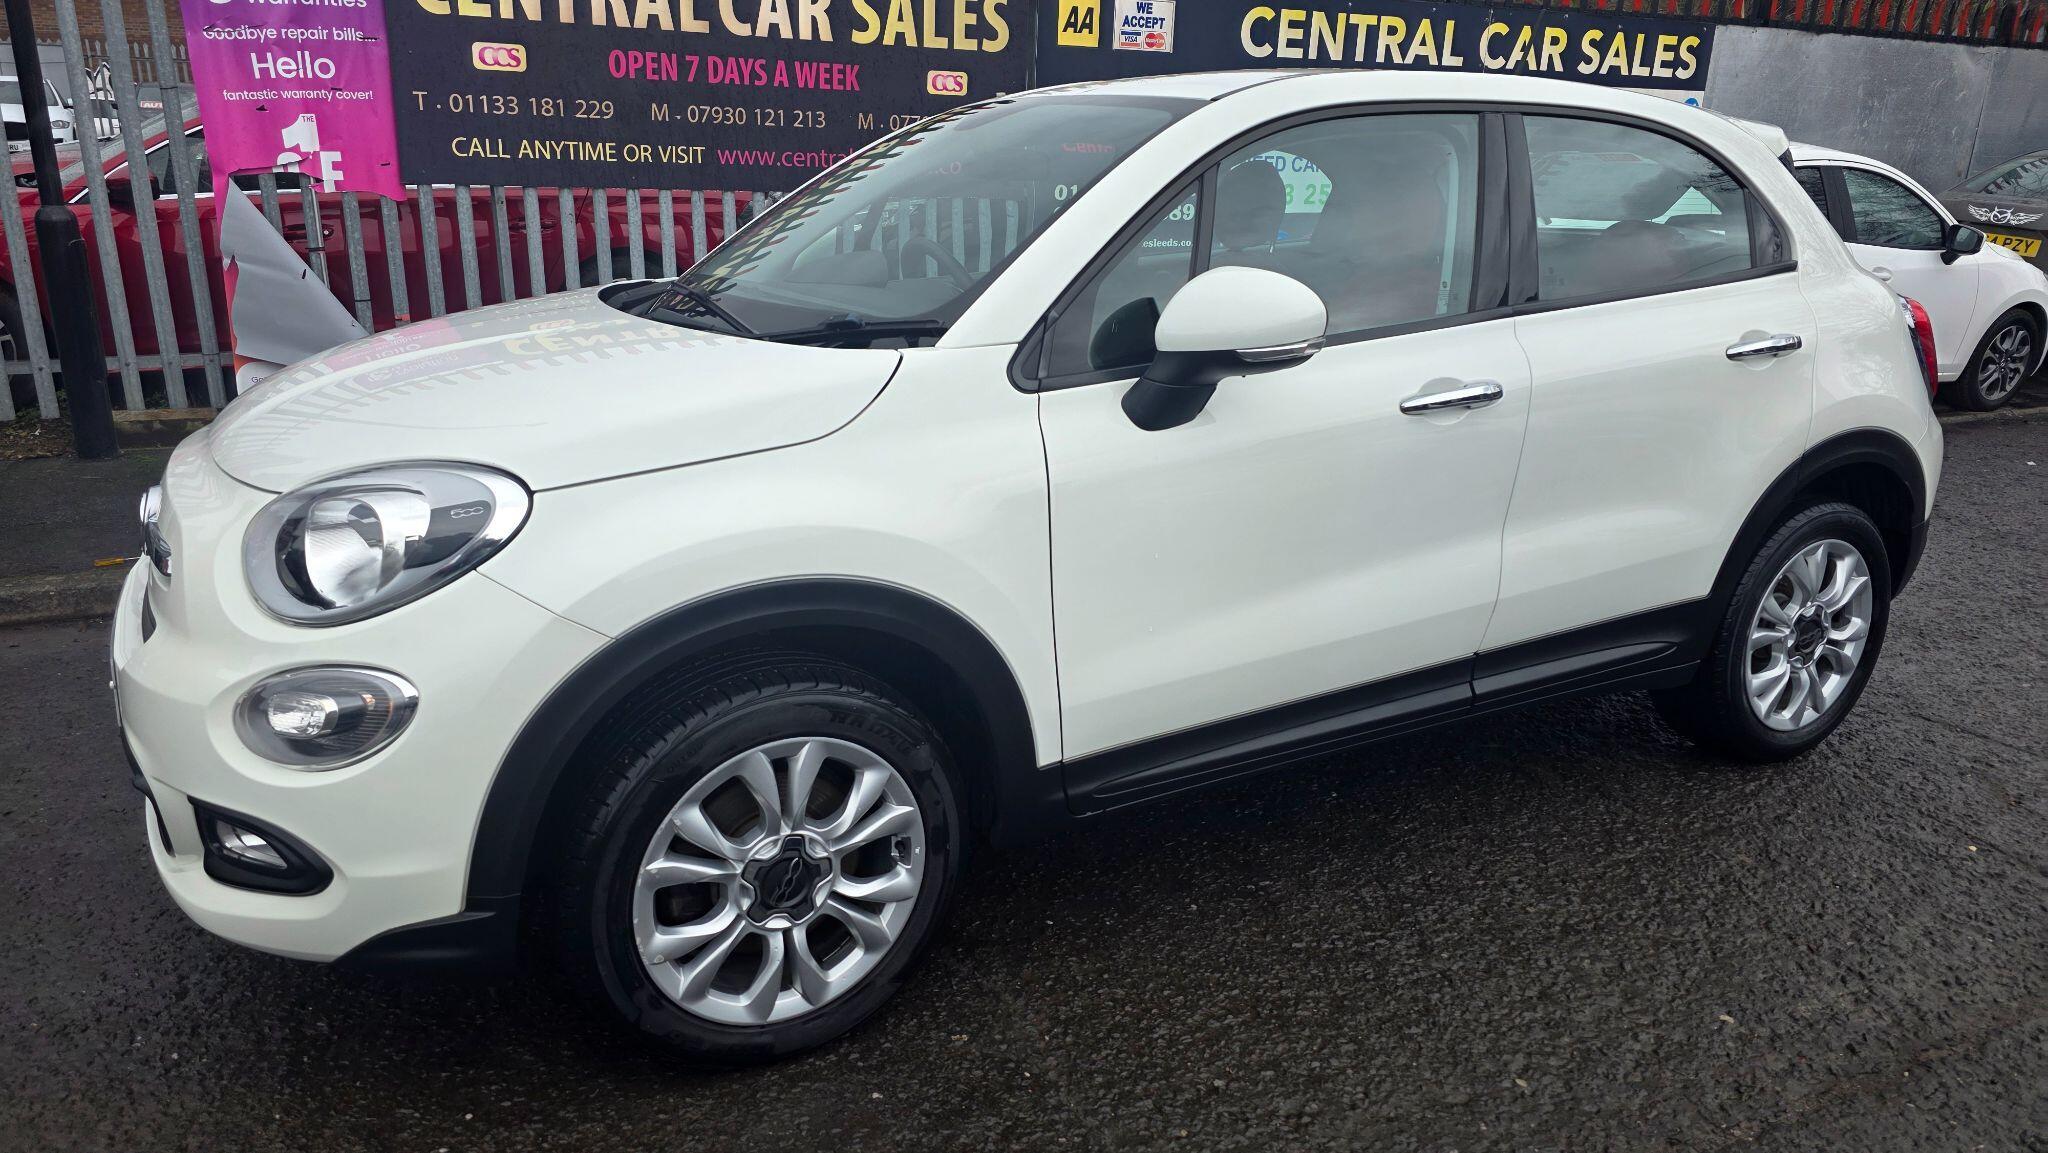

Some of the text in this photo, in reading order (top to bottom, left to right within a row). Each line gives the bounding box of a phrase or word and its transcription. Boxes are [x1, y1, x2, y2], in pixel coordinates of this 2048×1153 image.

[1062, 5, 1095, 35] AA
[1136, 1, 1154, 15] WE
[202, 24, 278, 44] Goodbye
[281, 26, 329, 44] repair
[719, 0, 833, 42] CAR
[851, 0, 1010, 53] SALES
[1121, 14, 1166, 30] ACCEPT
[1124, 35, 1138, 43] VISA
[1240, 6, 1701, 80] CENTRAL CAR SALES
[250, 50, 336, 79] Hello
[608, 49, 861, 92] OPEN 7 DAYS A WEEK
[222, 88, 374, 102] fantastic warranty cover!
[449, 93, 519, 115] 01133
[529, 97, 565, 117] 181
[575, 99, 614, 119] 229
[301, 115, 315, 123] THE
[687, 105, 747, 125] 07930
[754, 108, 784, 126] 121
[793, 110, 826, 128] 213
[451, 136, 511, 158] CALL
[518, 139, 618, 163] ANYTIME
[623, 143, 653, 163] OR
[658, 145, 706, 164] VISIT
